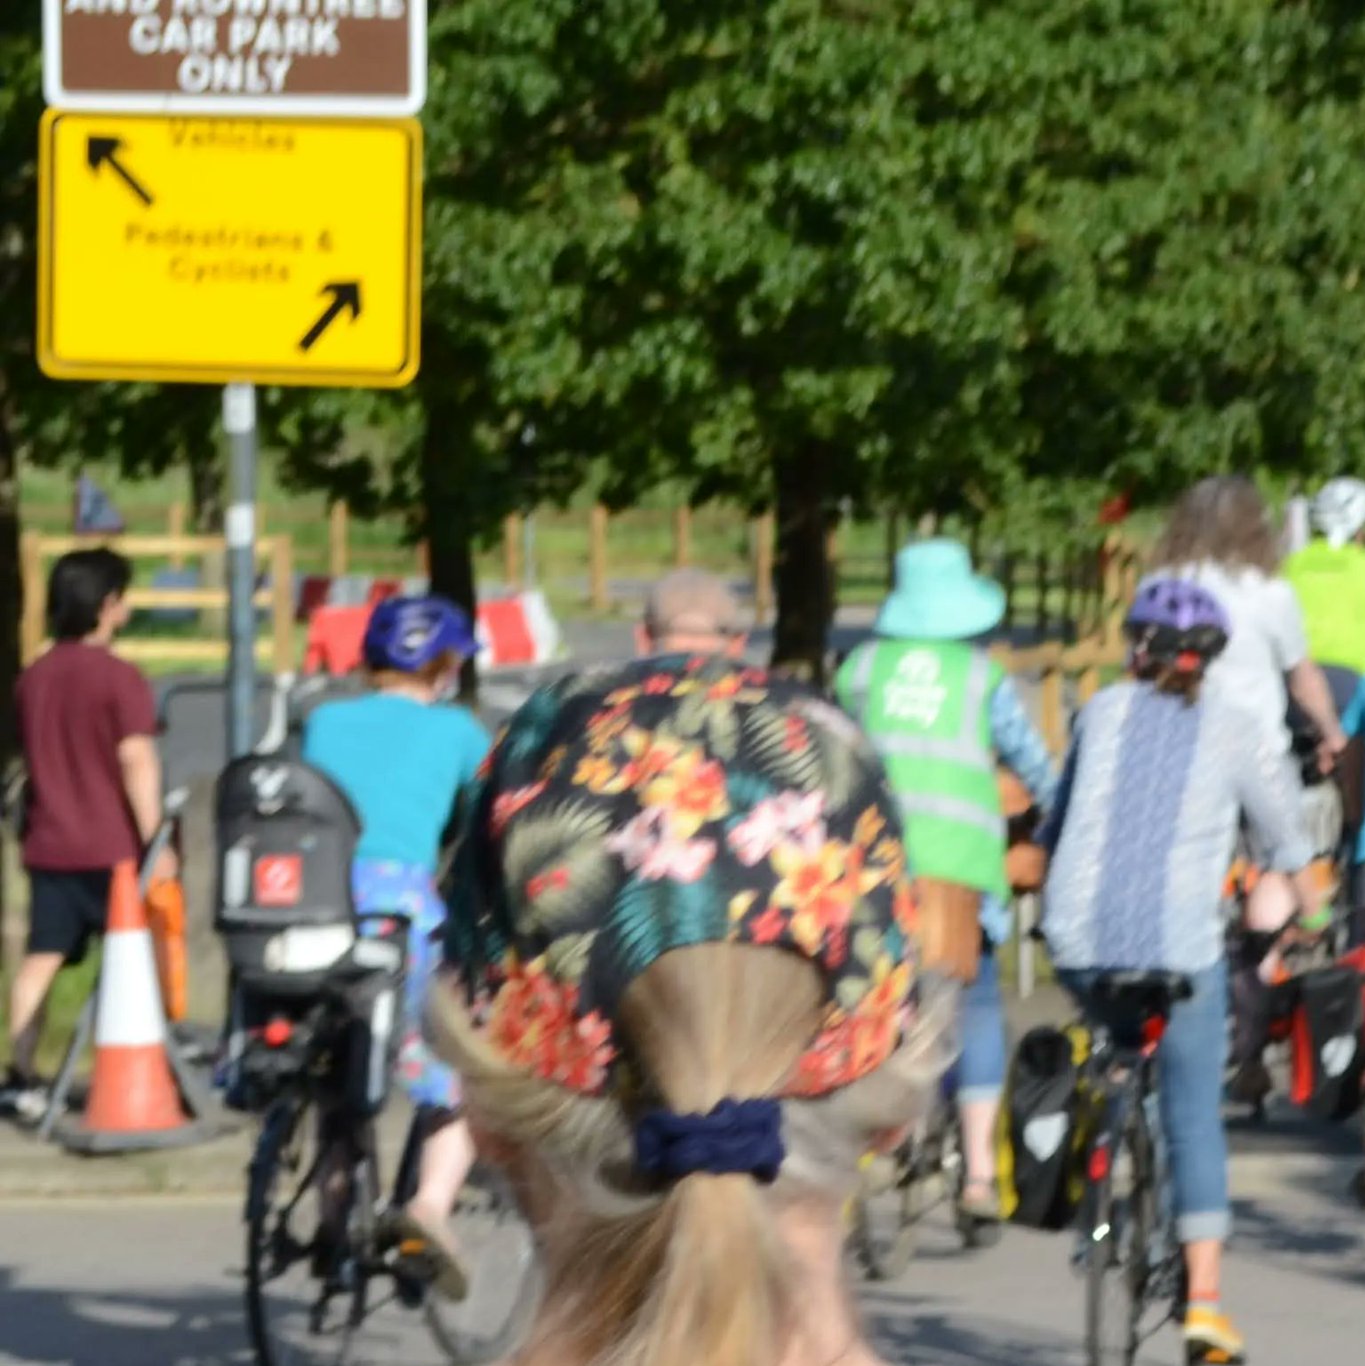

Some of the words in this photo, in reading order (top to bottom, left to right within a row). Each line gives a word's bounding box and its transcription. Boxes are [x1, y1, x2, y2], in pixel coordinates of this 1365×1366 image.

[129, 14, 217, 56] CAR
[229, 16, 341, 57] PARK
[176, 53, 293, 93] ONLY
[168, 119, 295, 150] Vehicles
[125, 222, 302, 250] Pedestrians
[169, 255, 290, 284] Cyclists
